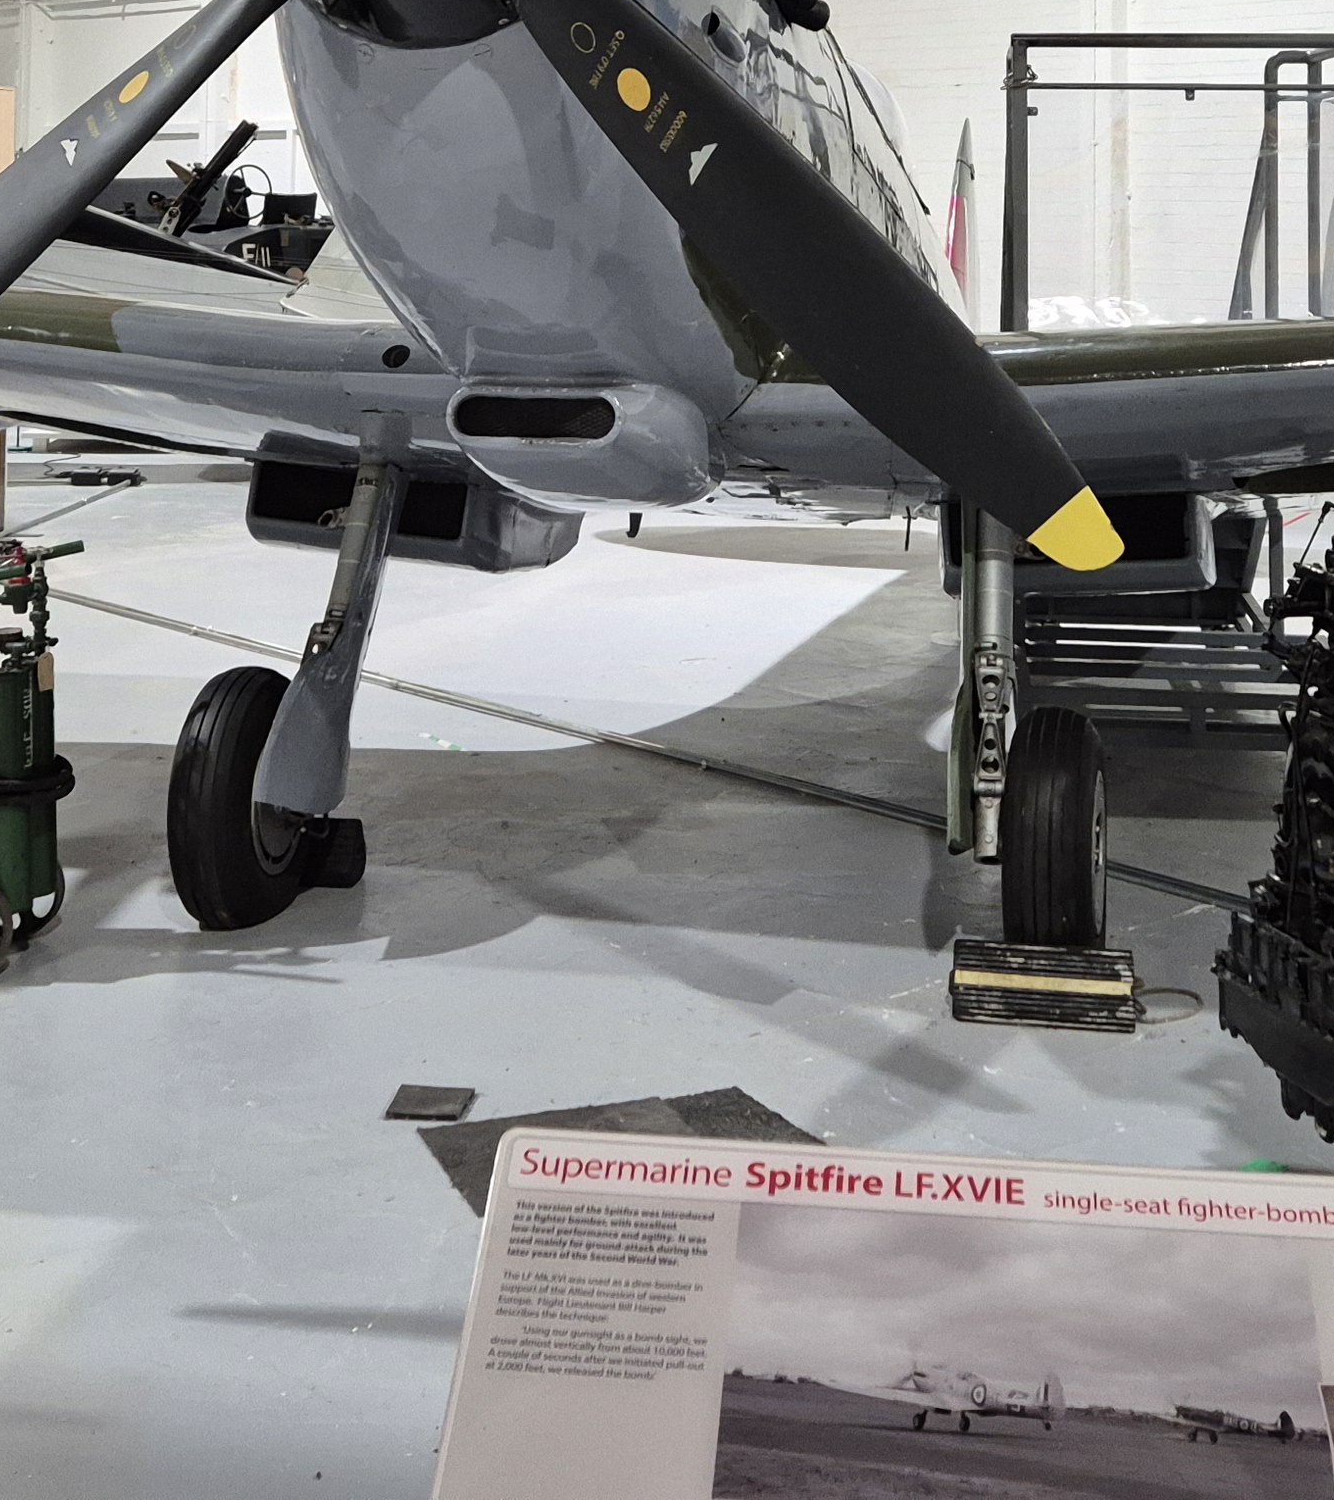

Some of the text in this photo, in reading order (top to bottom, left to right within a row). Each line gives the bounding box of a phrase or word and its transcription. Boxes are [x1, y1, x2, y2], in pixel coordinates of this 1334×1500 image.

[605, 38, 621, 59] SET
[519, 1148, 733, 1190] Supermarine
[745, 1161, 884, 1200] Spitfire
[895, 1170, 1026, 1205] LF.XVIE
[1043, 1189, 1170, 1219] single-seat
